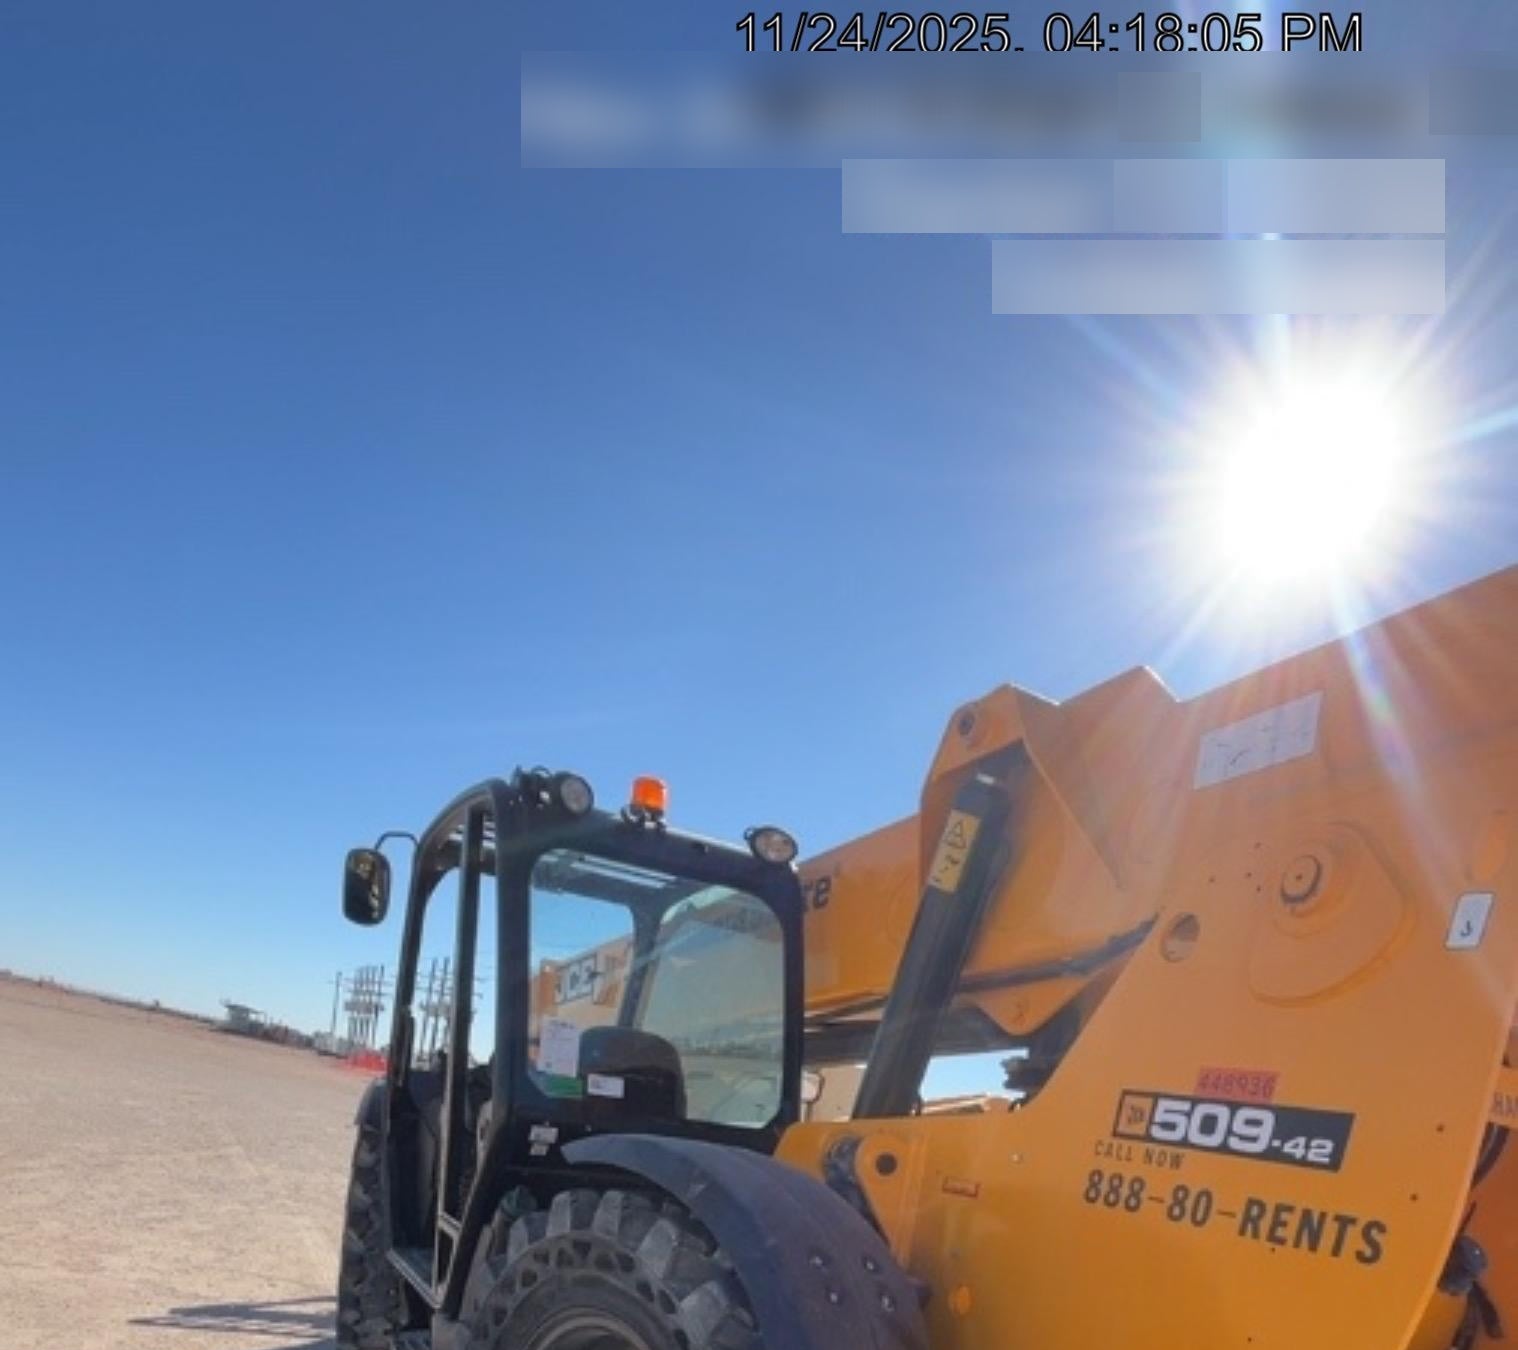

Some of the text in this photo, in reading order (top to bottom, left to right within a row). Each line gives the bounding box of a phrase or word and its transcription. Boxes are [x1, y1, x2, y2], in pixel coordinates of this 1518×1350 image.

[1094, 1139, 1185, 1170] CALL NOW
[1083, 1168, 1388, 1264] 888-80-RENTS
